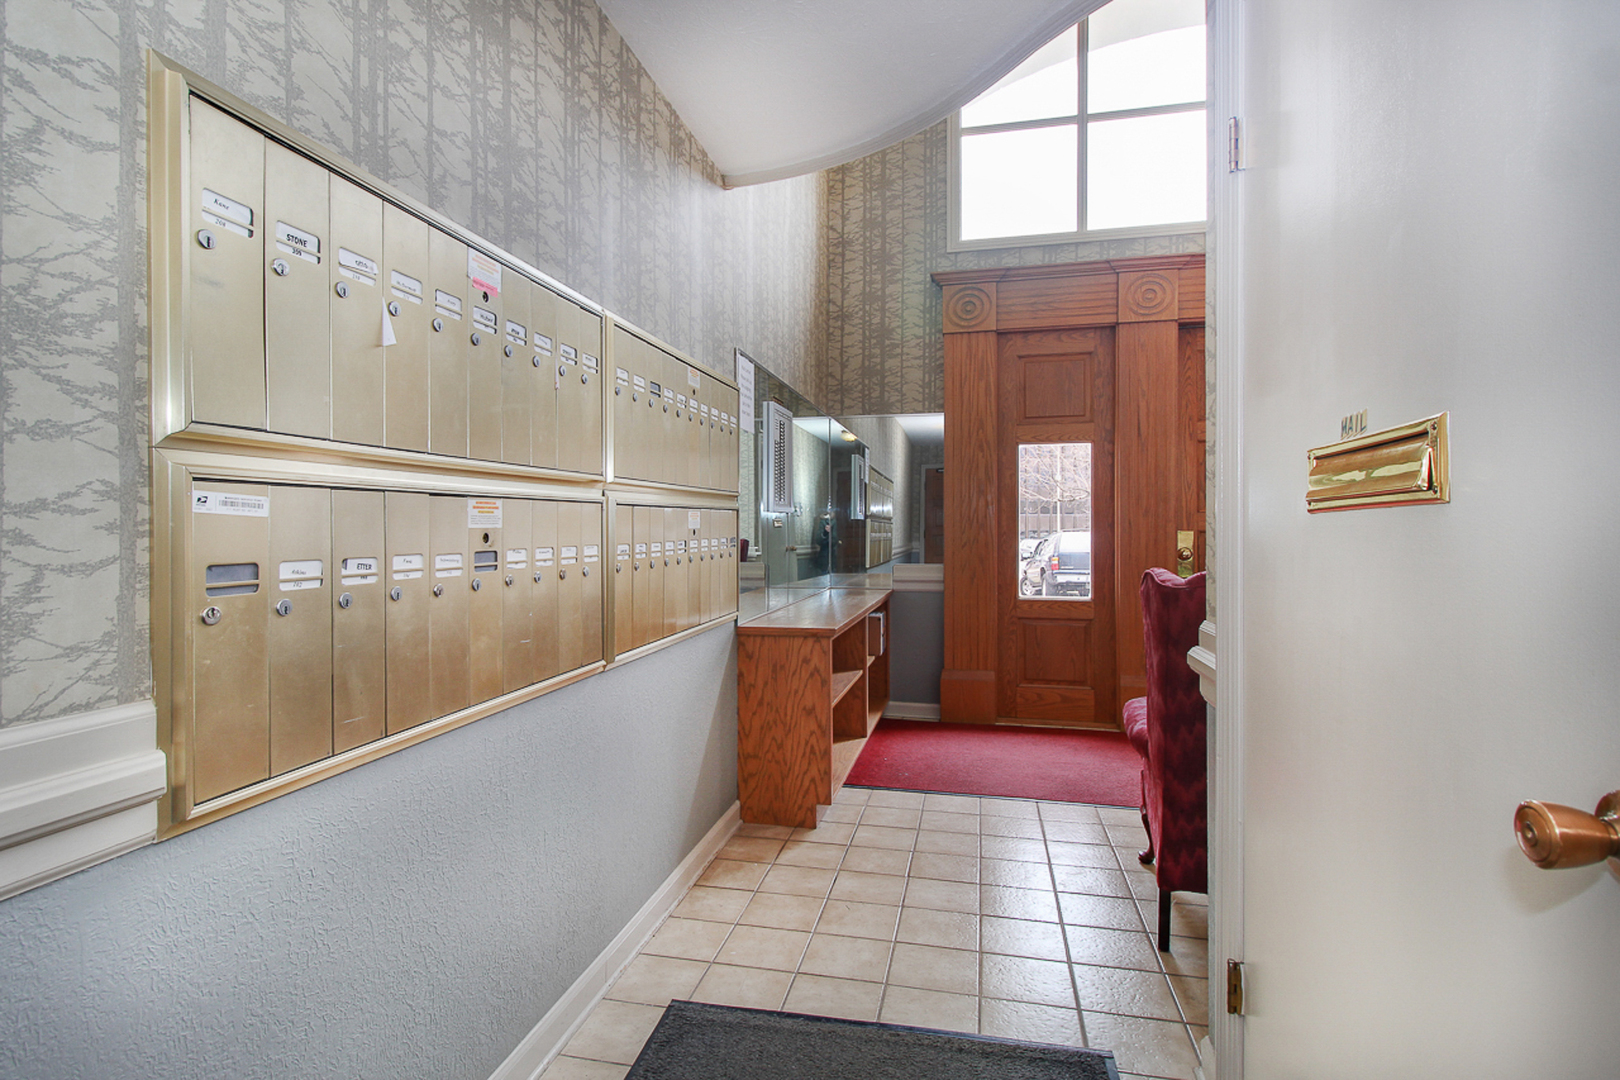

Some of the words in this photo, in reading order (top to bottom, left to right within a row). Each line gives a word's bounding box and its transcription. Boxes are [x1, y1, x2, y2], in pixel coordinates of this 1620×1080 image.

[286, 233, 308, 248] STONE
[1341, 411, 1367, 438] MAIL
[356, 562, 373, 571] ETTER
